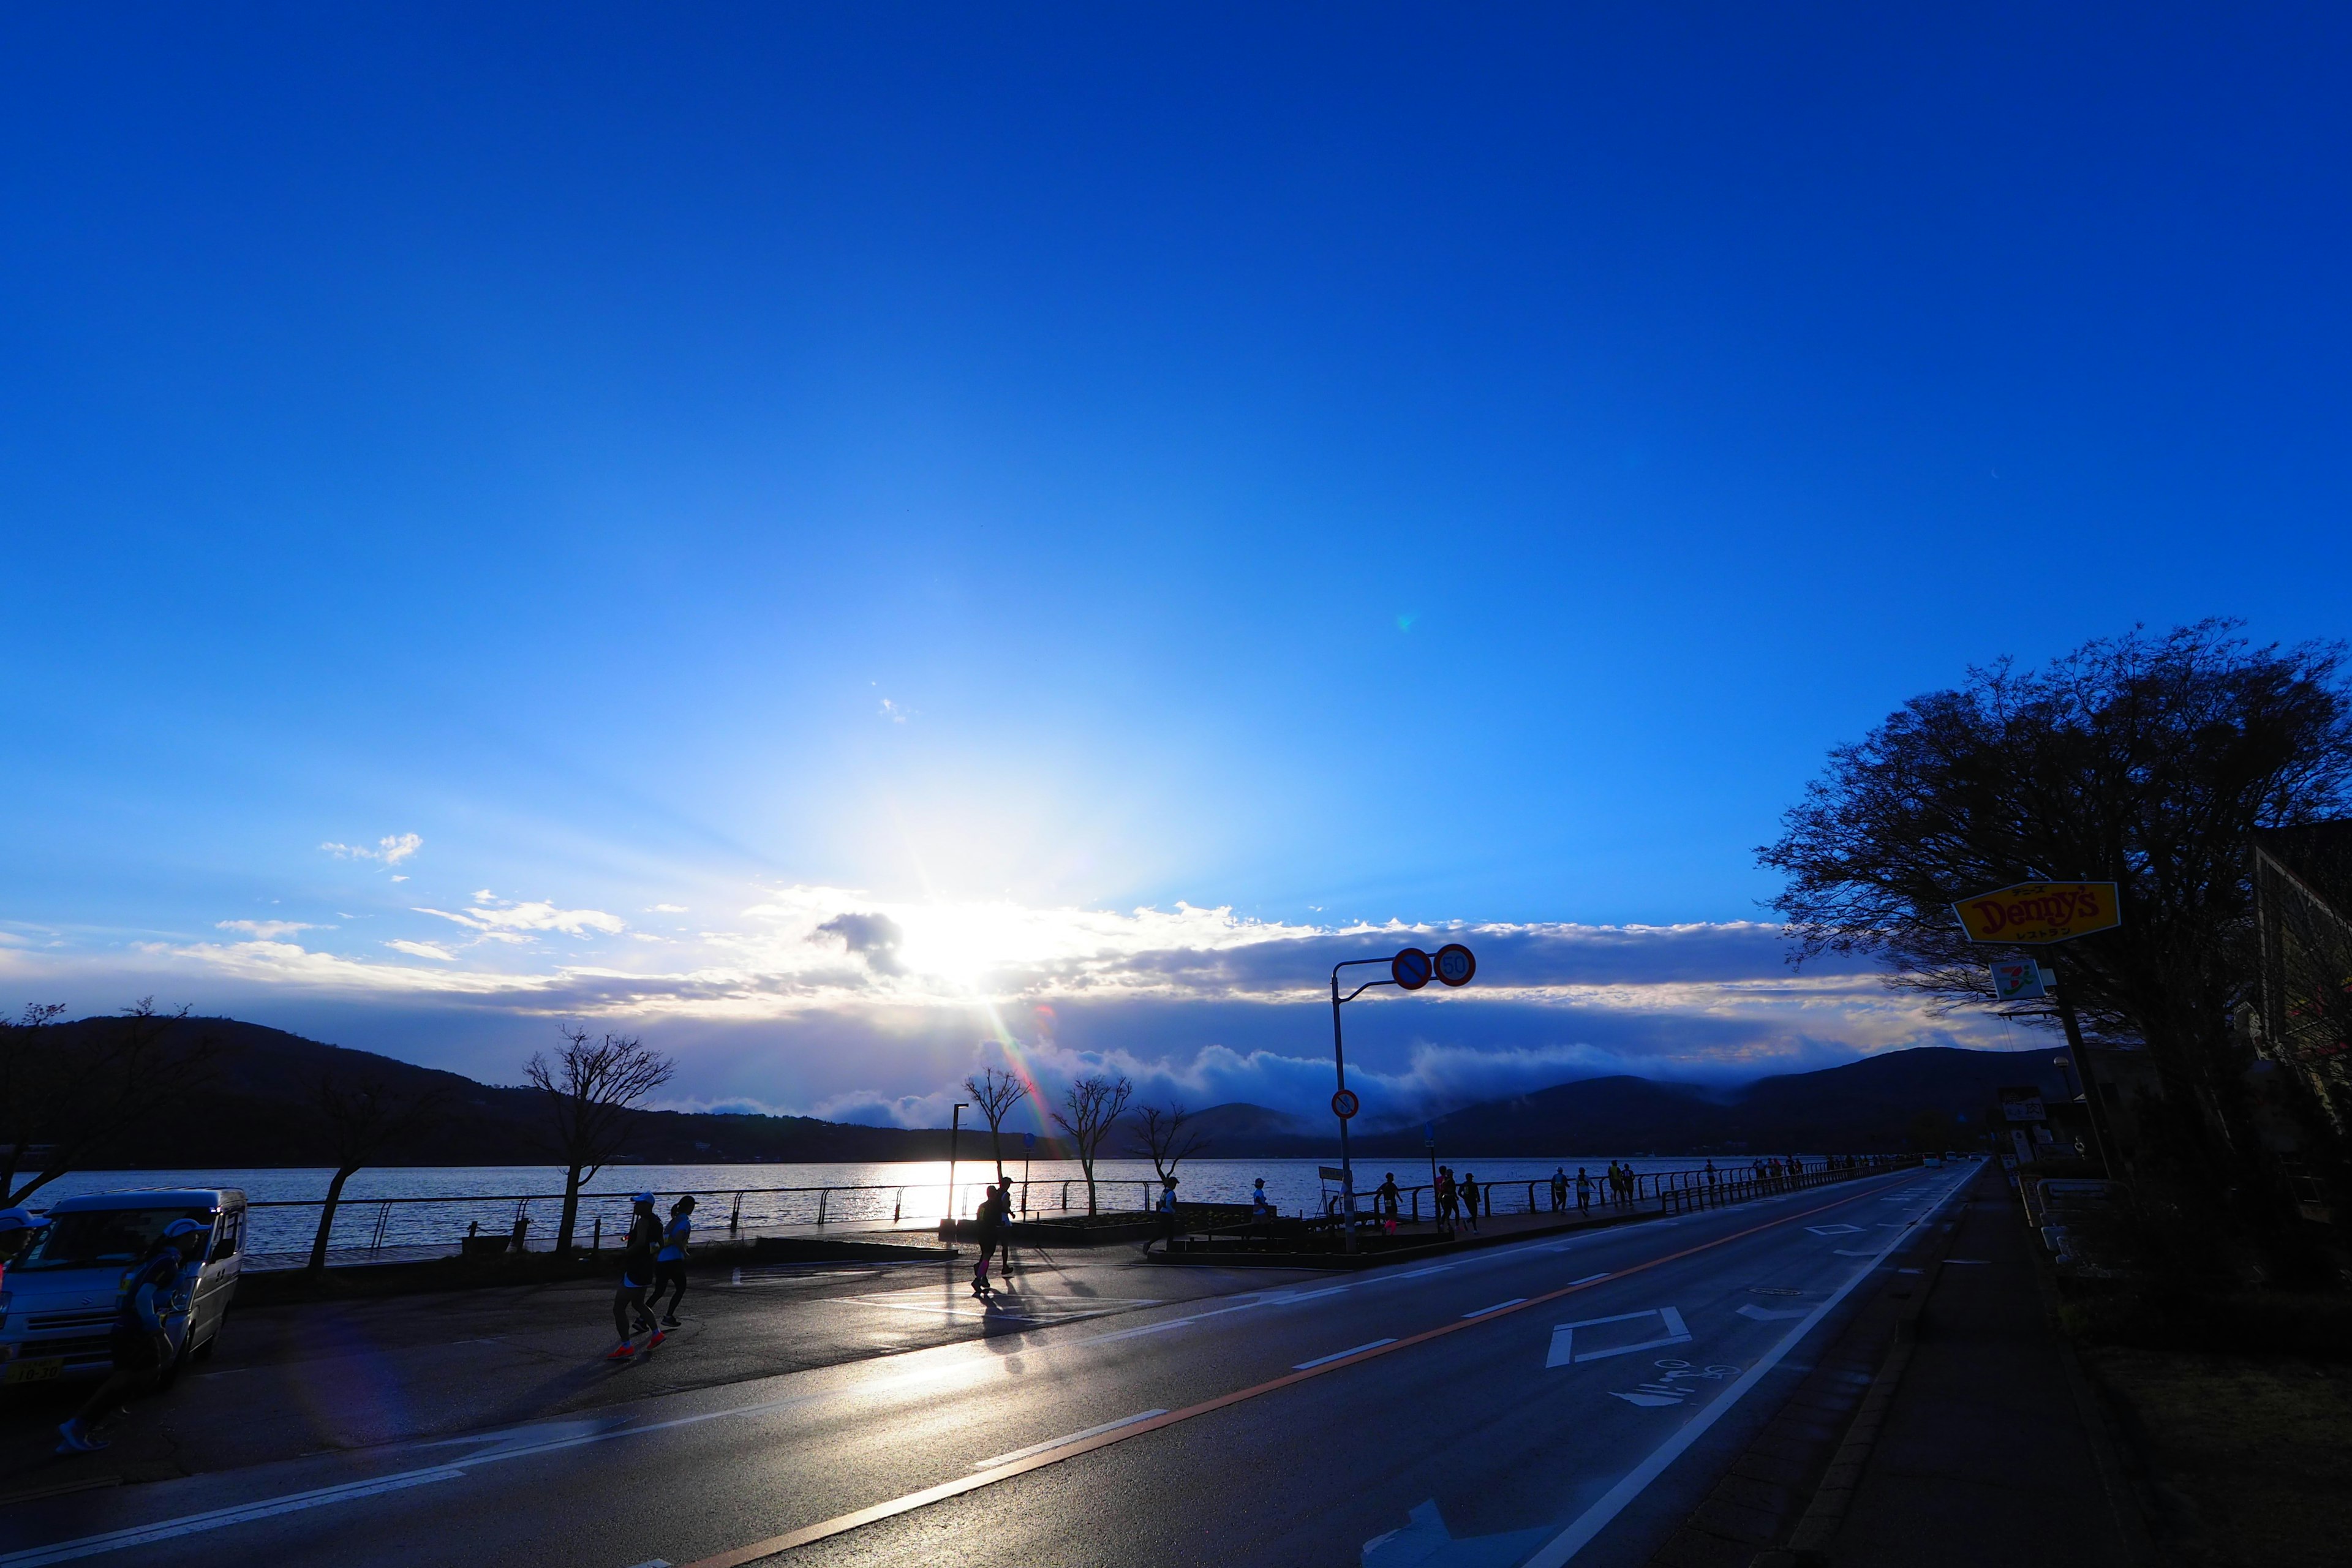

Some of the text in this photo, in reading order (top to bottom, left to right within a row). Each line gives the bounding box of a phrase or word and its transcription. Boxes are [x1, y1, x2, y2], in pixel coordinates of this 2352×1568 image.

[2011, 885, 2047, 896] デニーズ
[1972, 885, 2100, 935] Denny's
[2016, 927, 2070, 940] レストラン
[1443, 956, 1466, 974] 50
[19, 1366, 58, 1381] 10-30
